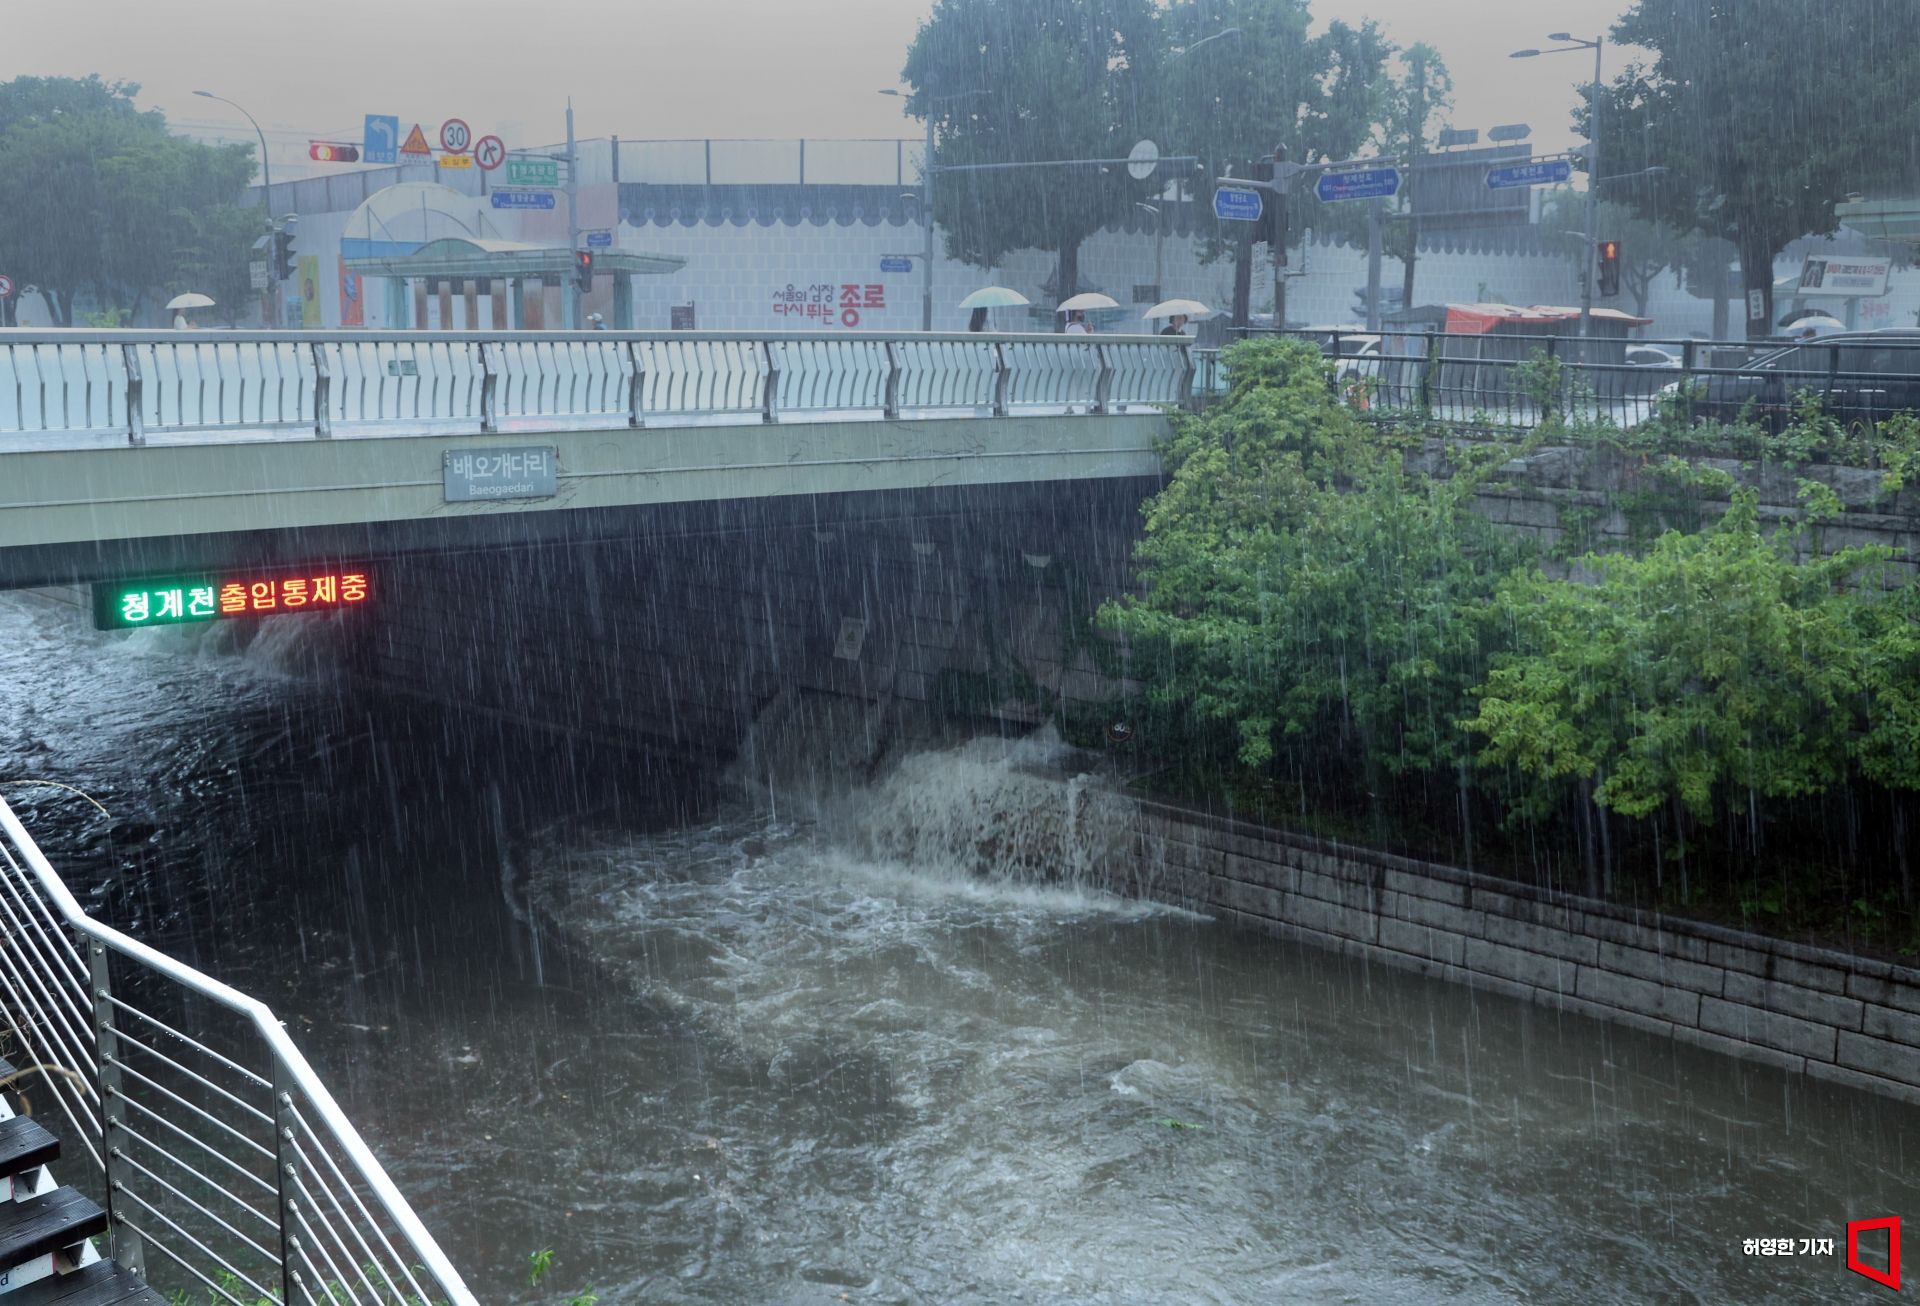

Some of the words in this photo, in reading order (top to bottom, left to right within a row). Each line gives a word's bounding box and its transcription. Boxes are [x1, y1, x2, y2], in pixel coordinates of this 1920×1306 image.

[447, 127, 465, 147] 30
[772, 284, 807, 302] 서울의
[809, 283, 834, 303] 심장
[772, 303, 803, 317] 다시
[806, 303, 834, 325] 뛰는
[839, 284, 886, 328] 종로
[453, 451, 548, 481] 배오개다리
[469, 481, 534, 496] Baeogaedari
[121, 586, 215, 622] 청계천
[219, 574, 367, 614] 출입통제중
